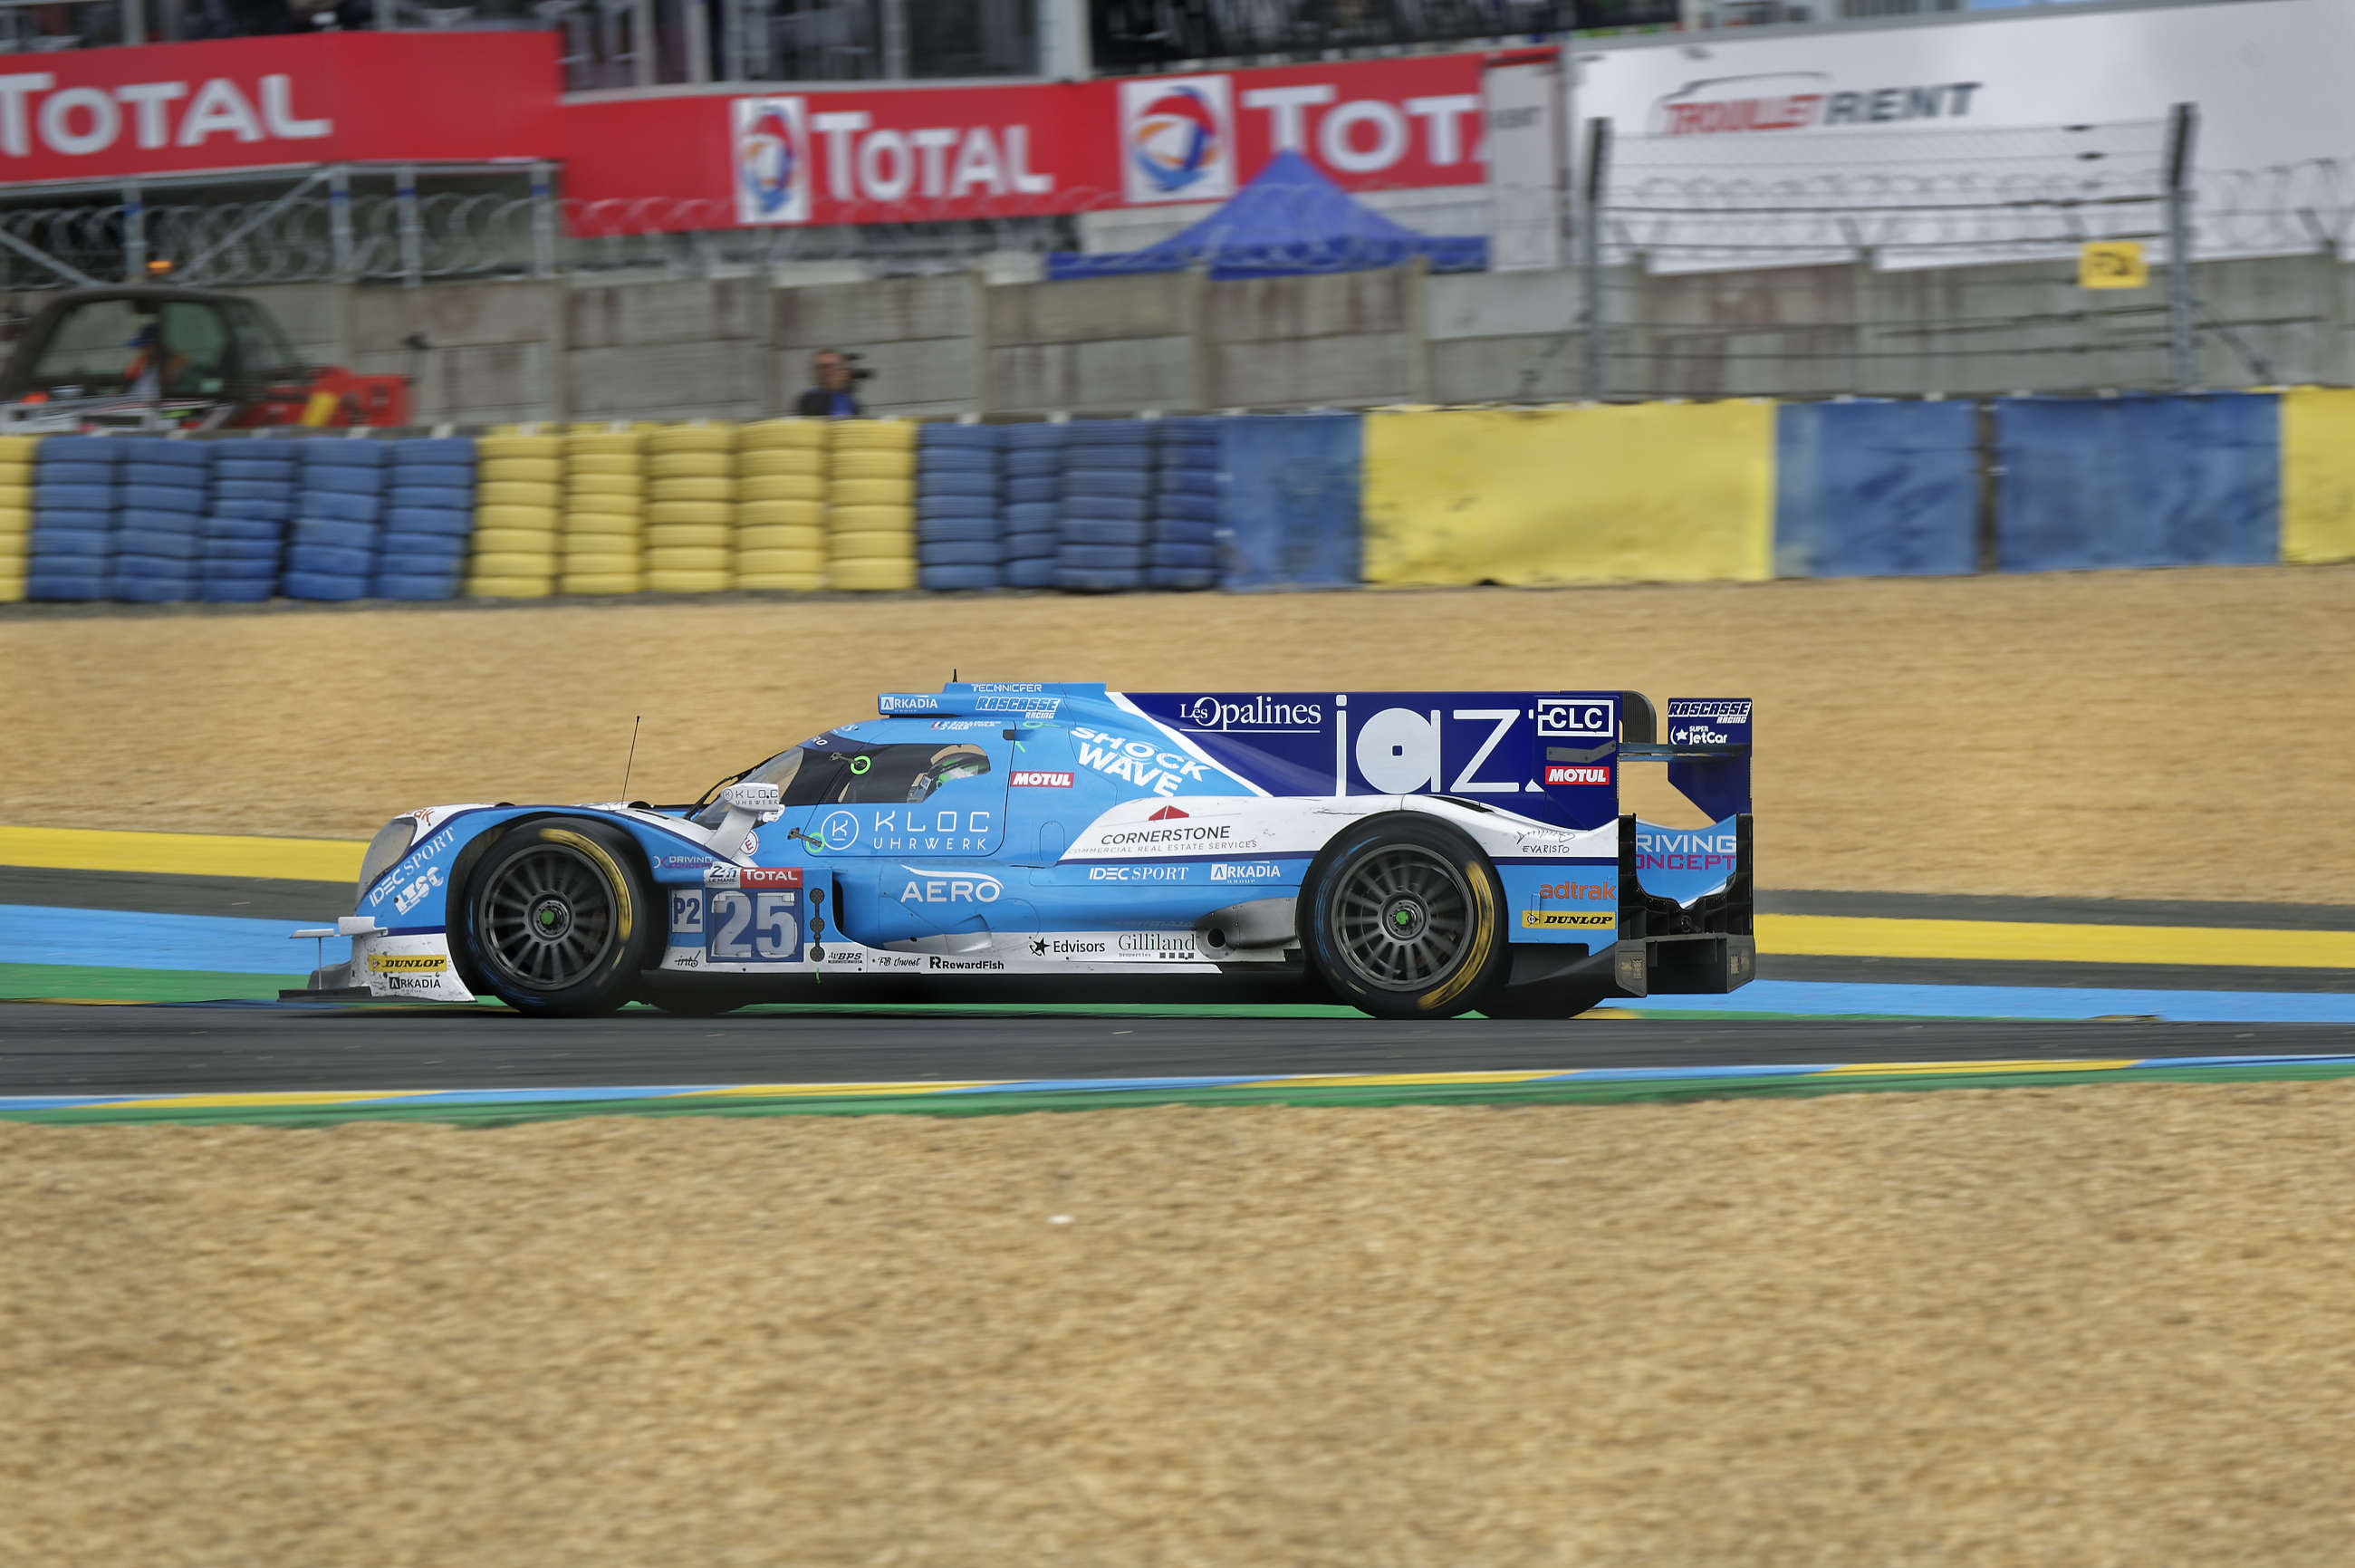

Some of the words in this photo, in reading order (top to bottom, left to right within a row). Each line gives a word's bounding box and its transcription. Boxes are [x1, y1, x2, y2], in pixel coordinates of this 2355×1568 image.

[1822, 82, 1984, 126] RENT
[0, 73, 332, 156] TOTAL
[1242, 84, 1486, 172] TOT
[811, 111, 1053, 200] TOTAL
[971, 684, 1042, 692] TECHNICFER
[976, 696, 1061, 712] RASCASSE
[1668, 701, 1752, 717] RASCASSE
[1180, 703, 1207, 718] Les
[1194, 696, 1322, 730] Opalines
[1549, 707, 1603, 728] CLC
[1336, 695, 1544, 796] jaz
[1070, 726, 1211, 782] SHOCK
[1078, 742, 1183, 797] WAVE
[1548, 768, 1606, 782] MOTUL
[1013, 773, 1072, 786] MOTUL
[735, 790, 778, 798] KLOC
[874, 811, 990, 832] KLOC
[1101, 825, 1231, 845] CORNERSTONE
[873, 838, 986, 850] UHRWERK
[1068, 846, 1132, 854] COMMERCIAL
[1138, 844, 1163, 852] REAL
[1168, 842, 1205, 851] ESTATE
[1208, 840, 1258, 850] SERVICES
[1523, 844, 1570, 853] EVARISTO
[1636, 834, 1736, 853] RIVING
[370, 869, 405, 908] IDEC
[404, 826, 456, 876] SPORT
[668, 855, 713, 863] DRIVING
[1636, 854, 1736, 870] ONCEPT
[743, 869, 798, 881] TOTAL
[1090, 867, 1130, 880] IDEC
[1131, 866, 1190, 880] SPORT
[900, 880, 1001, 903] AERO
[1539, 880, 1617, 900] adtrak
[673, 897, 701, 925] P2
[711, 890, 798, 958] 25
[1544, 916, 1612, 924] DUNLOP
[1053, 940, 1106, 952] Edvisors
[1119, 934, 1196, 951] Gilliland
[383, 959, 445, 968] DUNLOP
[942, 959, 1004, 970] RewardFish
[389, 976, 441, 989] ARKADIA
